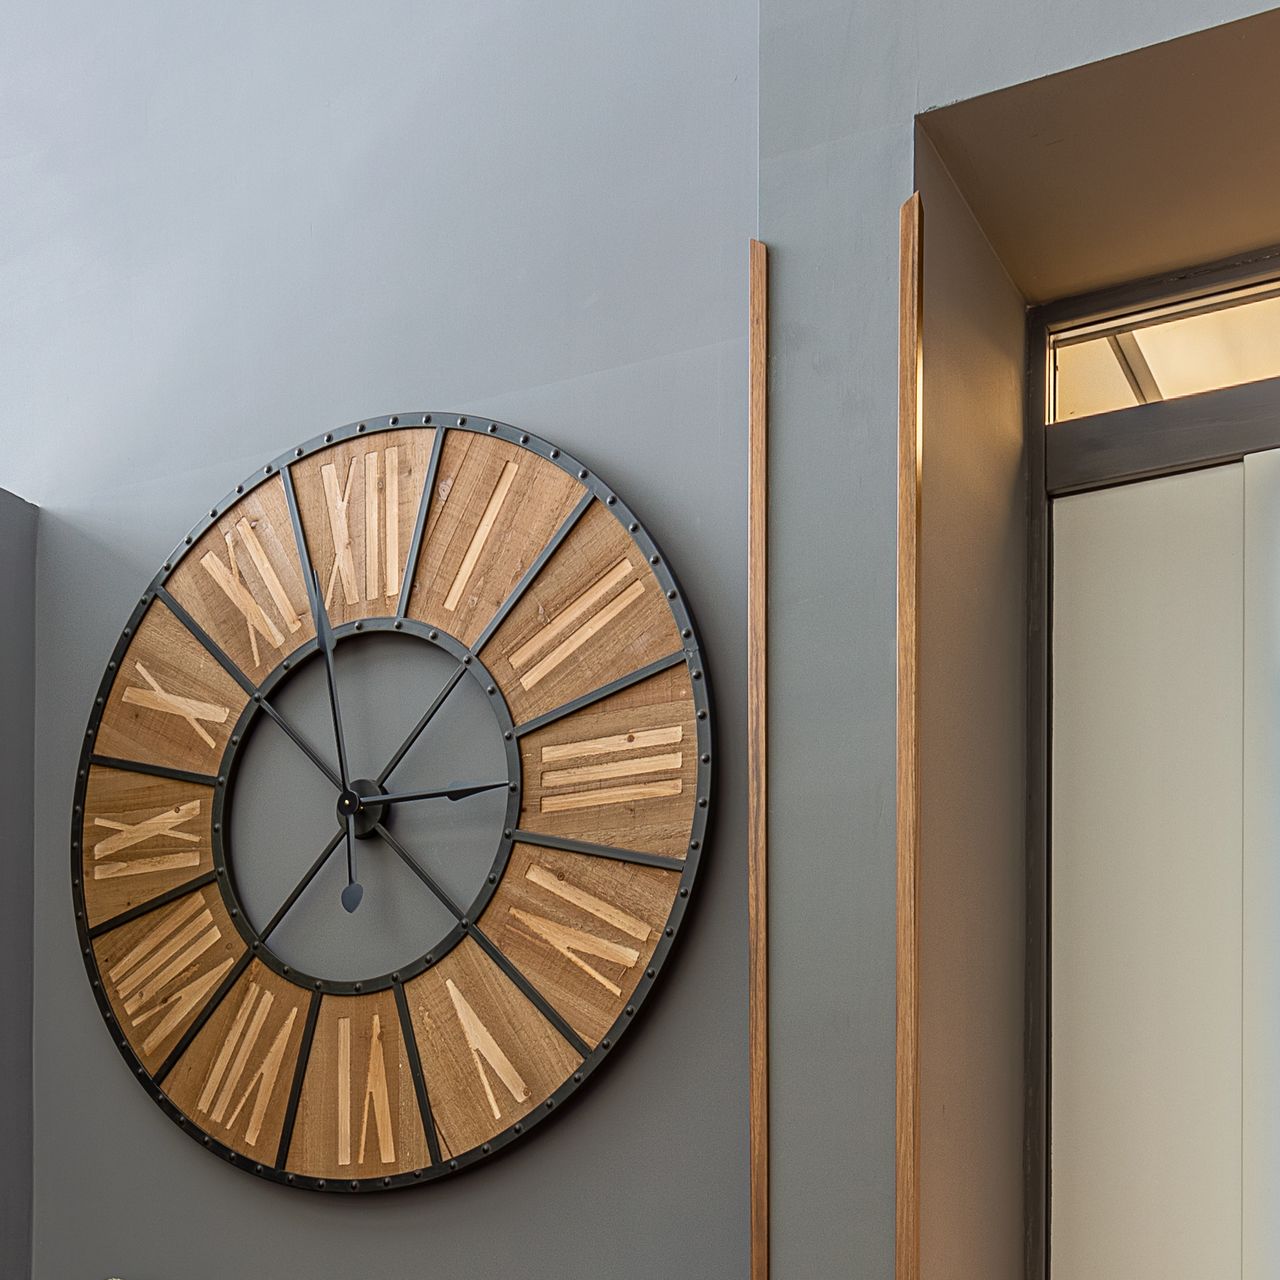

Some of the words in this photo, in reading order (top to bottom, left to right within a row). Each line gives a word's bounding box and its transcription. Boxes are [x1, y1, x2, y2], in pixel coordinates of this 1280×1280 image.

[199, 515, 301, 667] XI
[321, 446, 400, 608] XII
[444, 460, 518, 611] I
[508, 556, 644, 692] II
[121, 661, 230, 749] X
[540, 725, 682, 812] III
[93, 799, 201, 880] IX
[108, 889, 235, 1055] VIII
[197, 982, 298, 1146] VII
[338, 1013, 395, 1165] VI
[444, 978, 531, 1120] V
